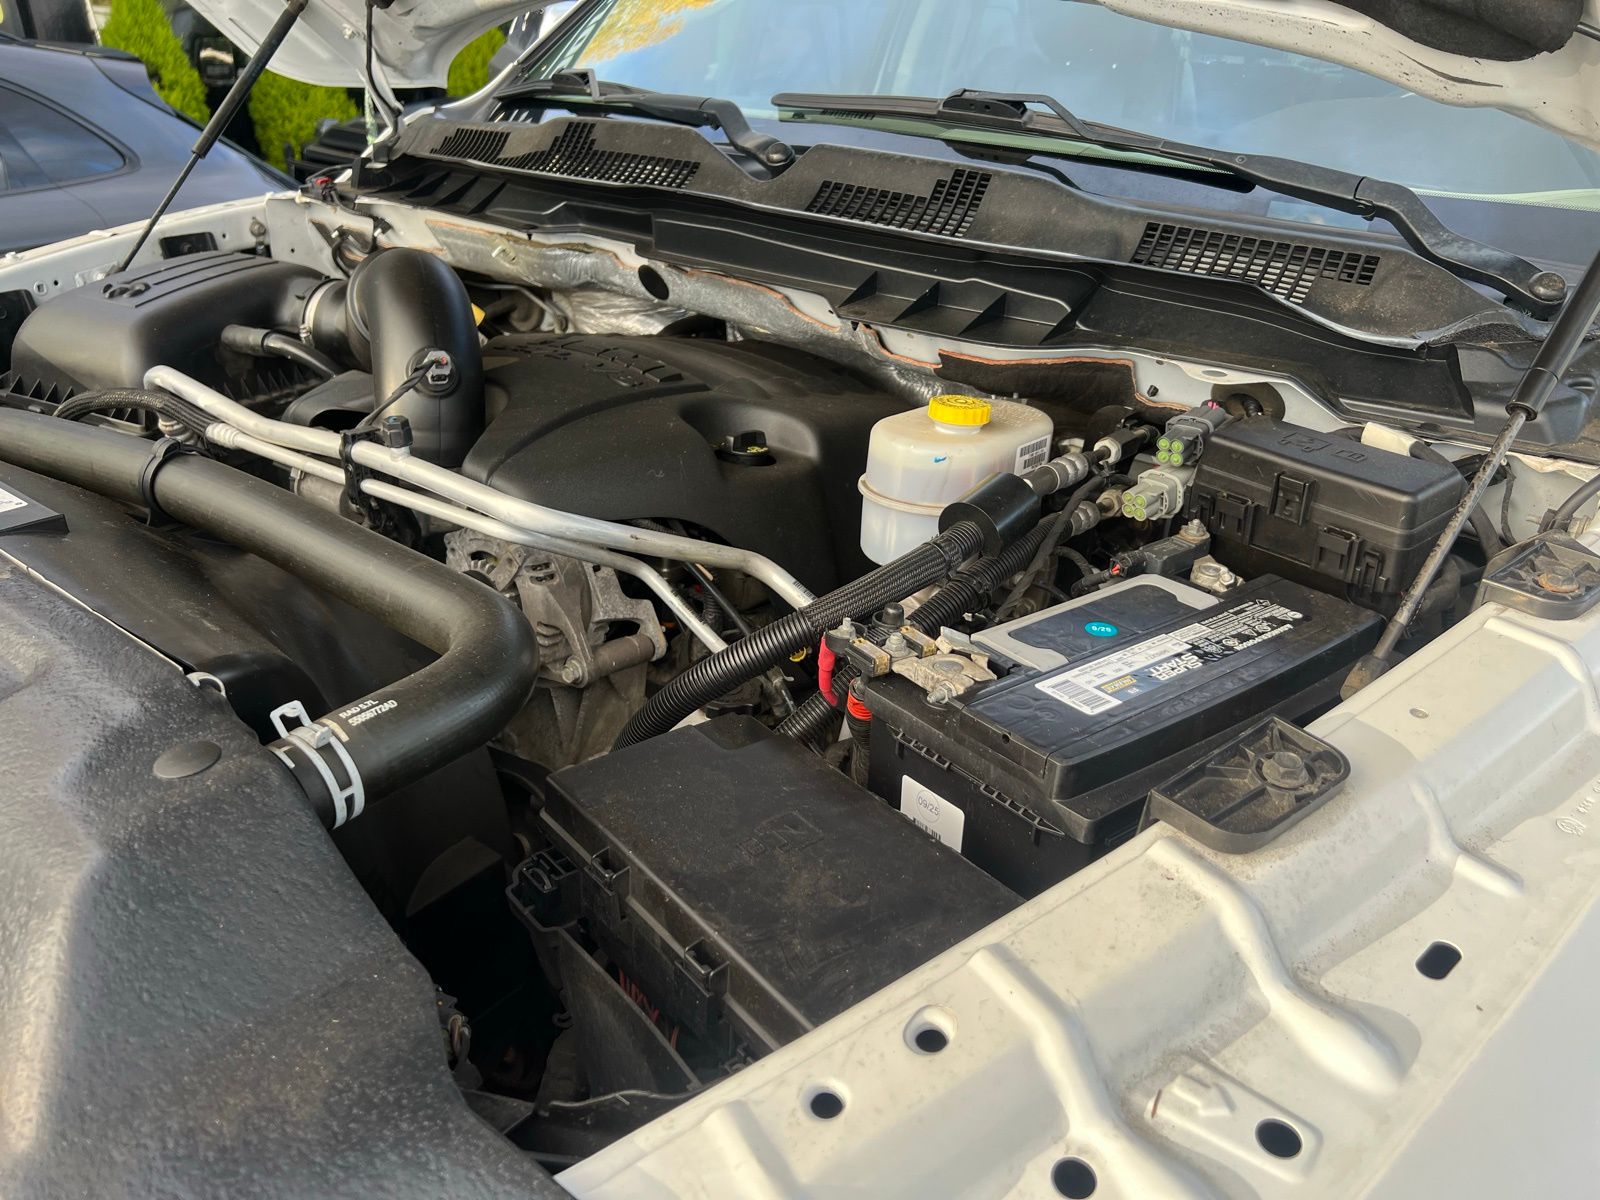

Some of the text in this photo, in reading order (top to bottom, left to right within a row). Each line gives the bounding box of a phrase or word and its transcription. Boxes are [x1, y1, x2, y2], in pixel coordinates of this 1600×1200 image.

[1149, 652, 1199, 677] START
[1155, 660, 1203, 681] SUPER
[917, 796, 940, 816] 09/25
